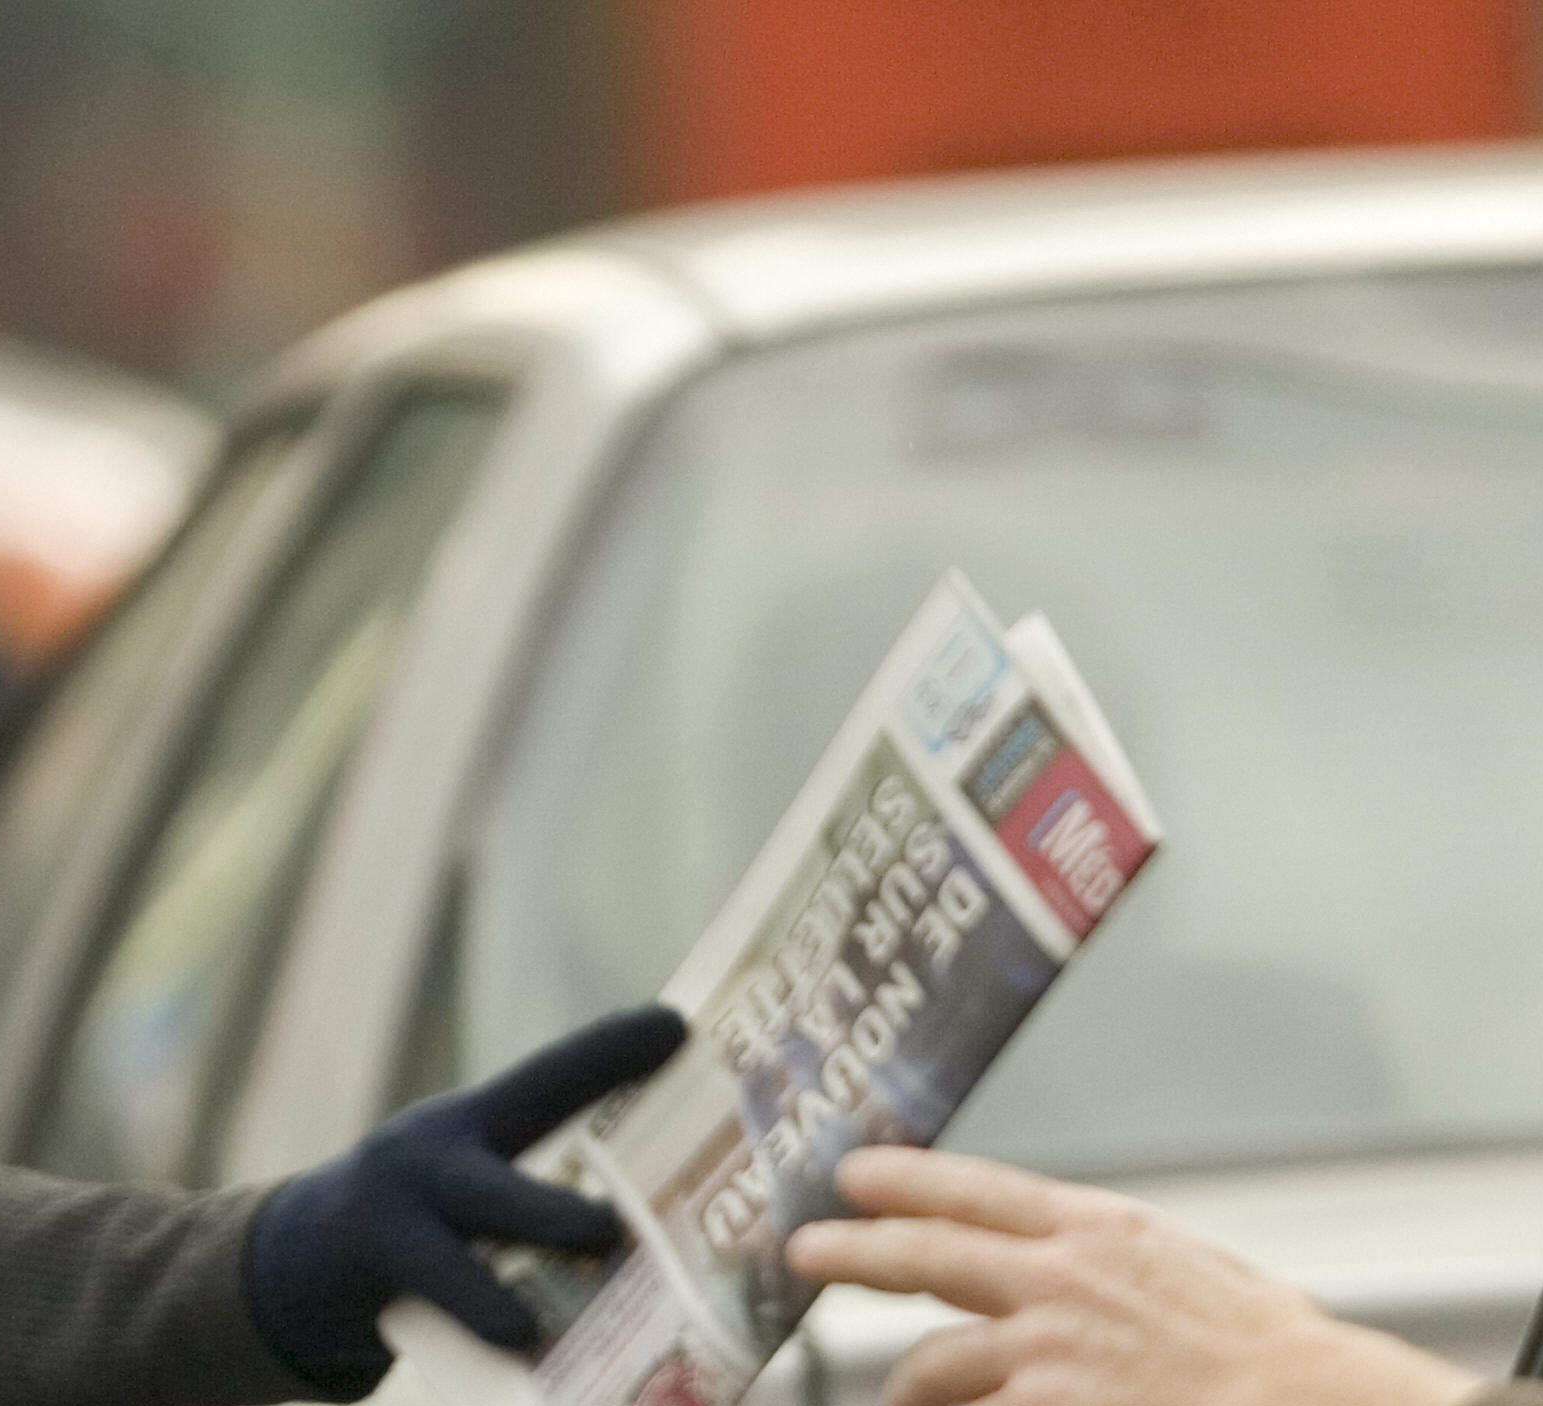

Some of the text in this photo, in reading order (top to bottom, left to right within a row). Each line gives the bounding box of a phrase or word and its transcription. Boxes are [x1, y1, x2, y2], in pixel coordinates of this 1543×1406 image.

[712, 773, 918, 1074] SELLETTE
[794, 820, 952, 1050] SUR LA
[912, 866, 990, 968] DE
[703, 958, 926, 1250] NOUVEAU
